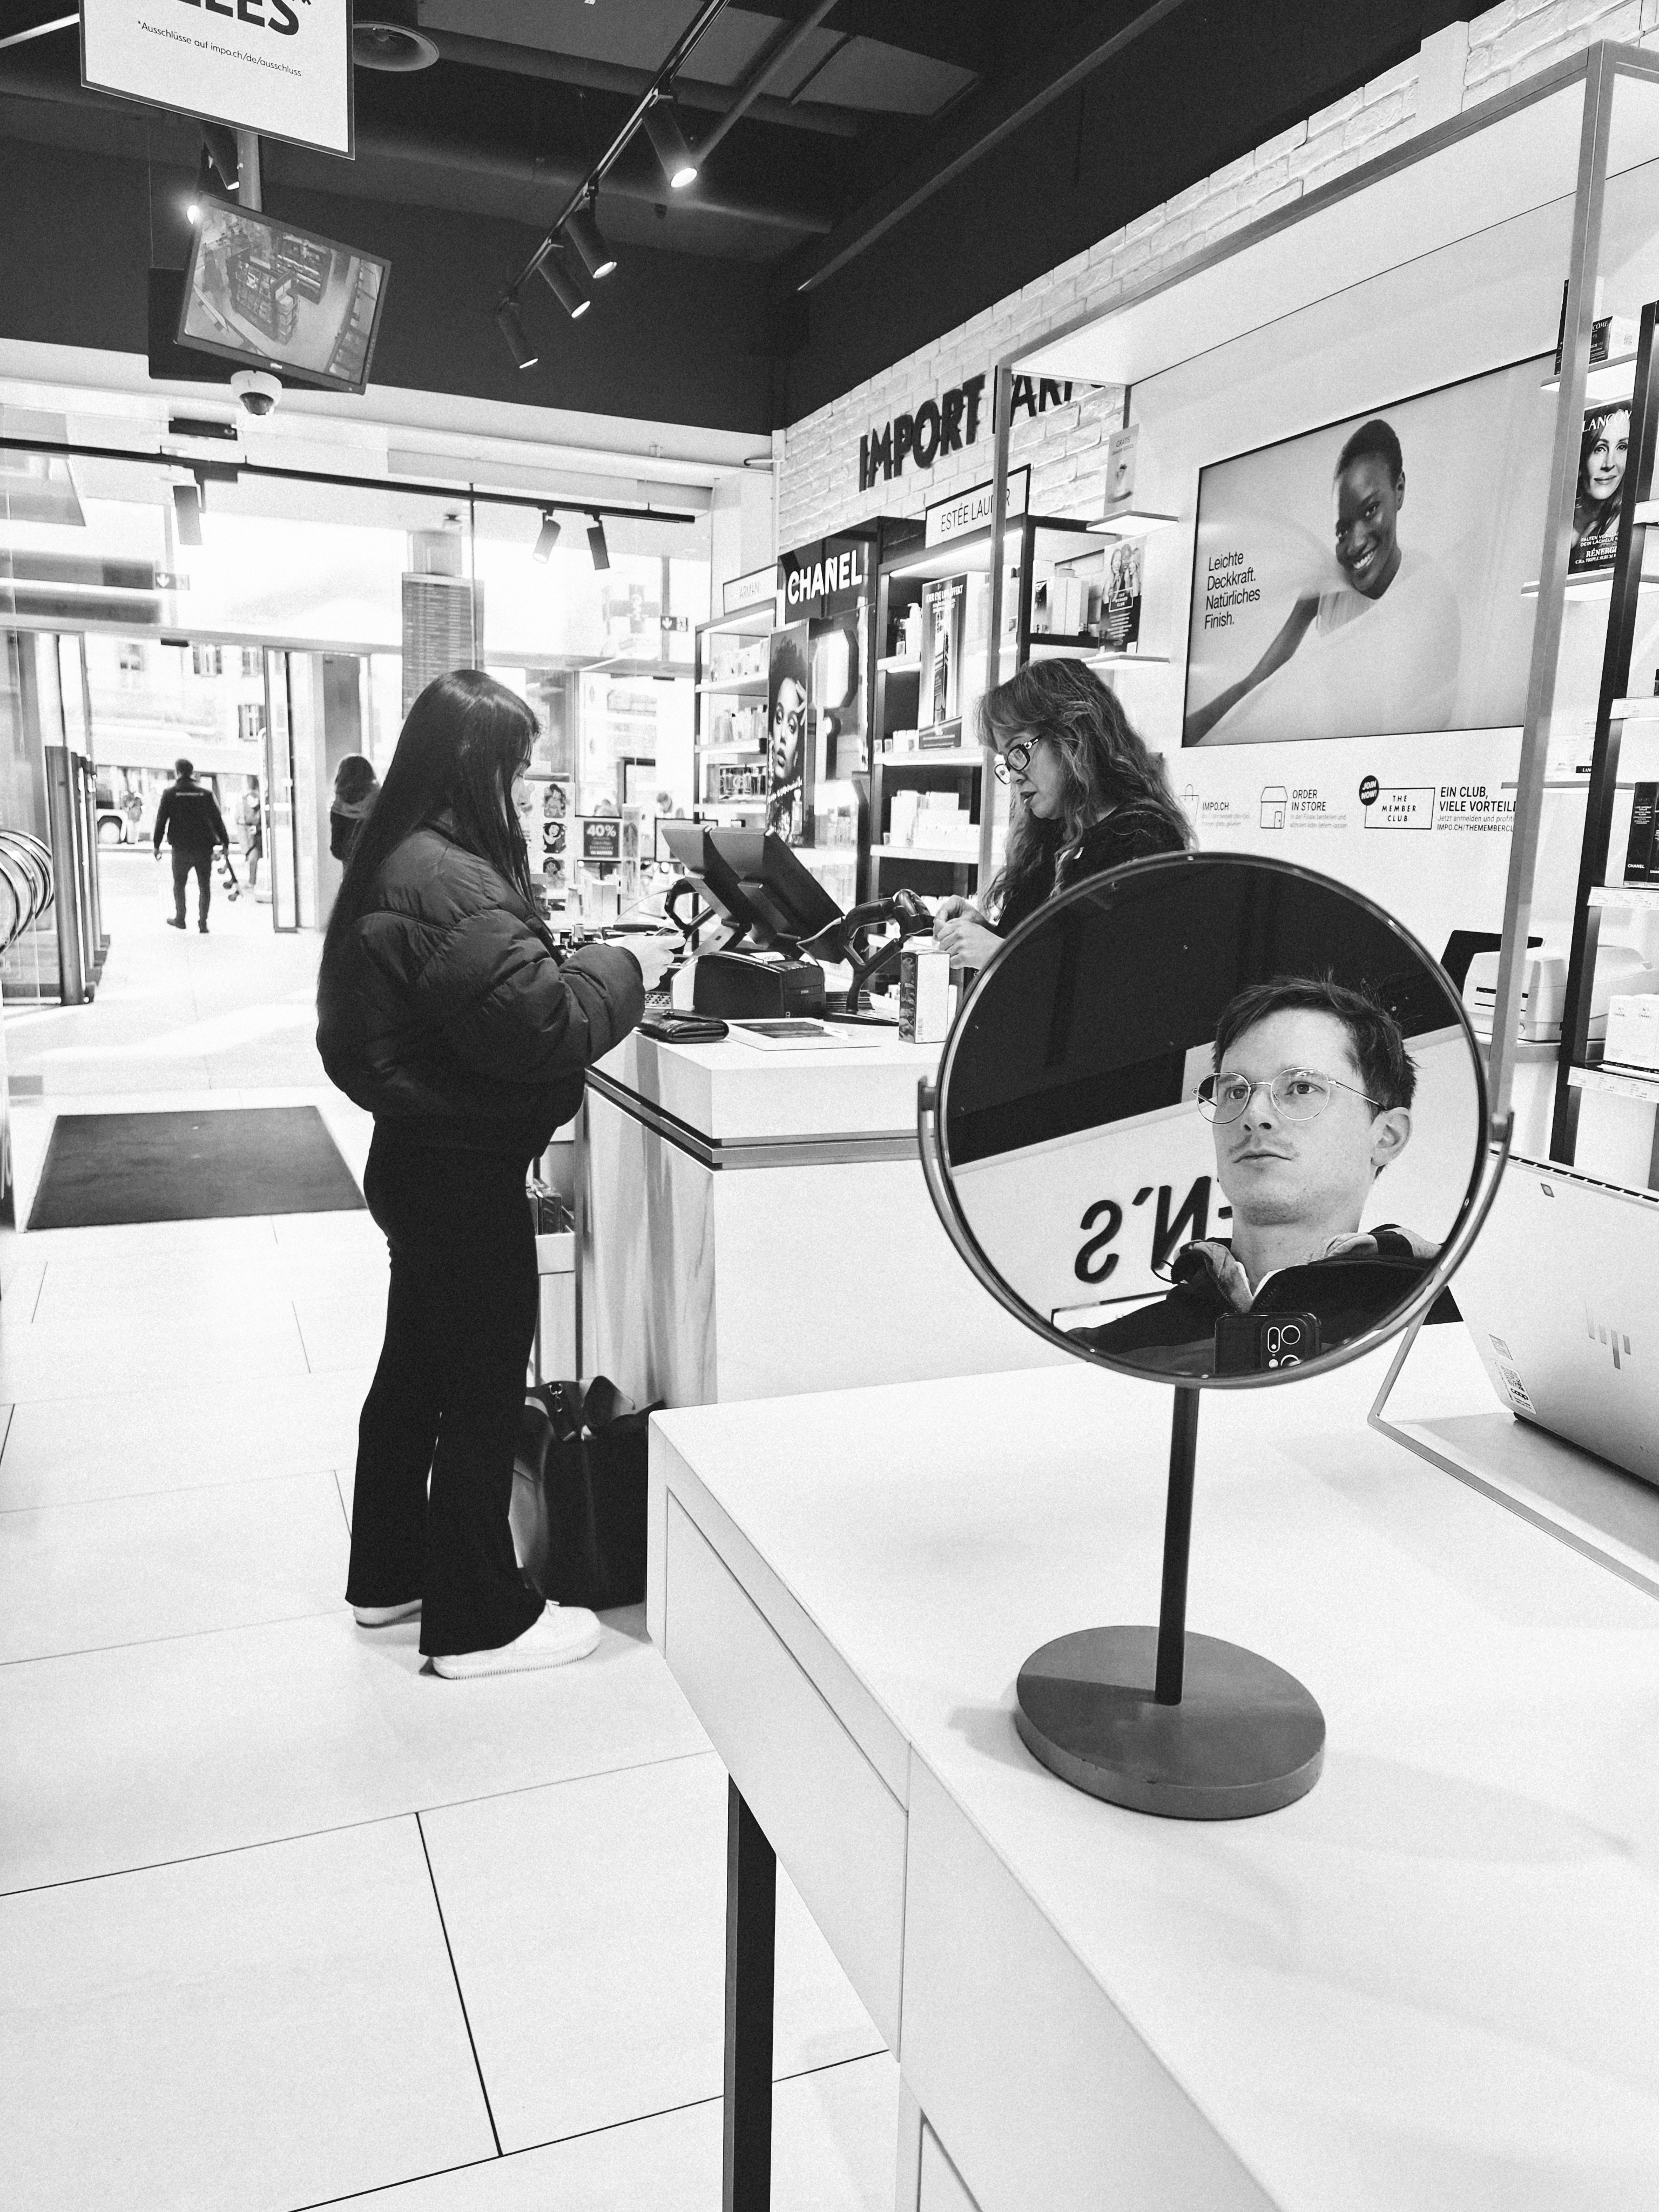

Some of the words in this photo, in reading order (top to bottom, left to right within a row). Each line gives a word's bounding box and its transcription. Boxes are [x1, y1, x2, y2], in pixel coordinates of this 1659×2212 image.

[194, 40, 208, 49] auf
[211, 43, 302, 77] impo.ch/de/ausschluss
[859, 374, 986, 492] IMPORT
[941, 502, 969, 532] ESTÉE
[972, 488, 1010, 521] LAUR
[1209, 551, 1244, 571] Leichte
[787, 549, 862, 604] CHANEL
[1208, 567, 1256, 591] Deckkraft.
[1206, 588, 1260, 610] Natürliches
[1204, 611, 1235, 629] Finish.
[1362, 780, 1377, 791] JOIN
[1440, 787, 1456, 797] EIN
[1460, 786, 1488, 799] CLUB,
[1292, 789, 1318, 799] ORDER
[1361, 789, 1378, 800] NOW!
[1202, 801, 1229, 811] IMPO.CH
[1291, 801, 1299, 811] IN
[1301, 801, 1326, 812] STORE
[1440, 801, 1467, 812] VIELE
[586, 824, 617, 837] 40%
